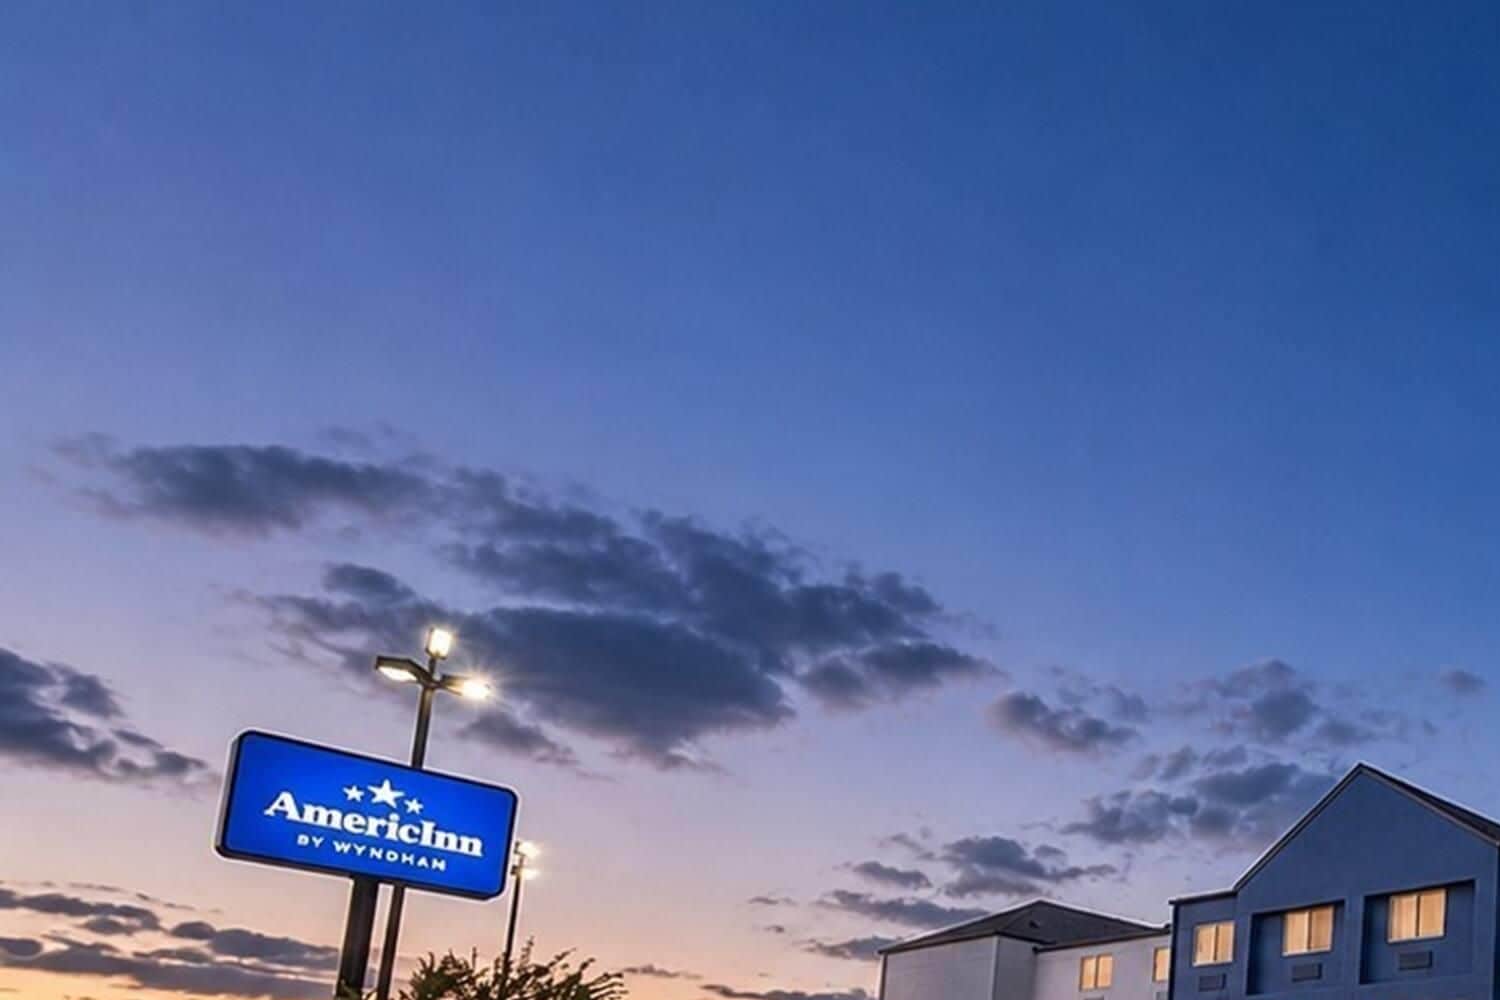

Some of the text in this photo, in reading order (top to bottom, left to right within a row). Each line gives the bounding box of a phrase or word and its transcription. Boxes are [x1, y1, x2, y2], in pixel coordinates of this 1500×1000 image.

[263, 791, 483, 857] AmericInn
[296, 833, 447, 872] BY WYNDHAM
